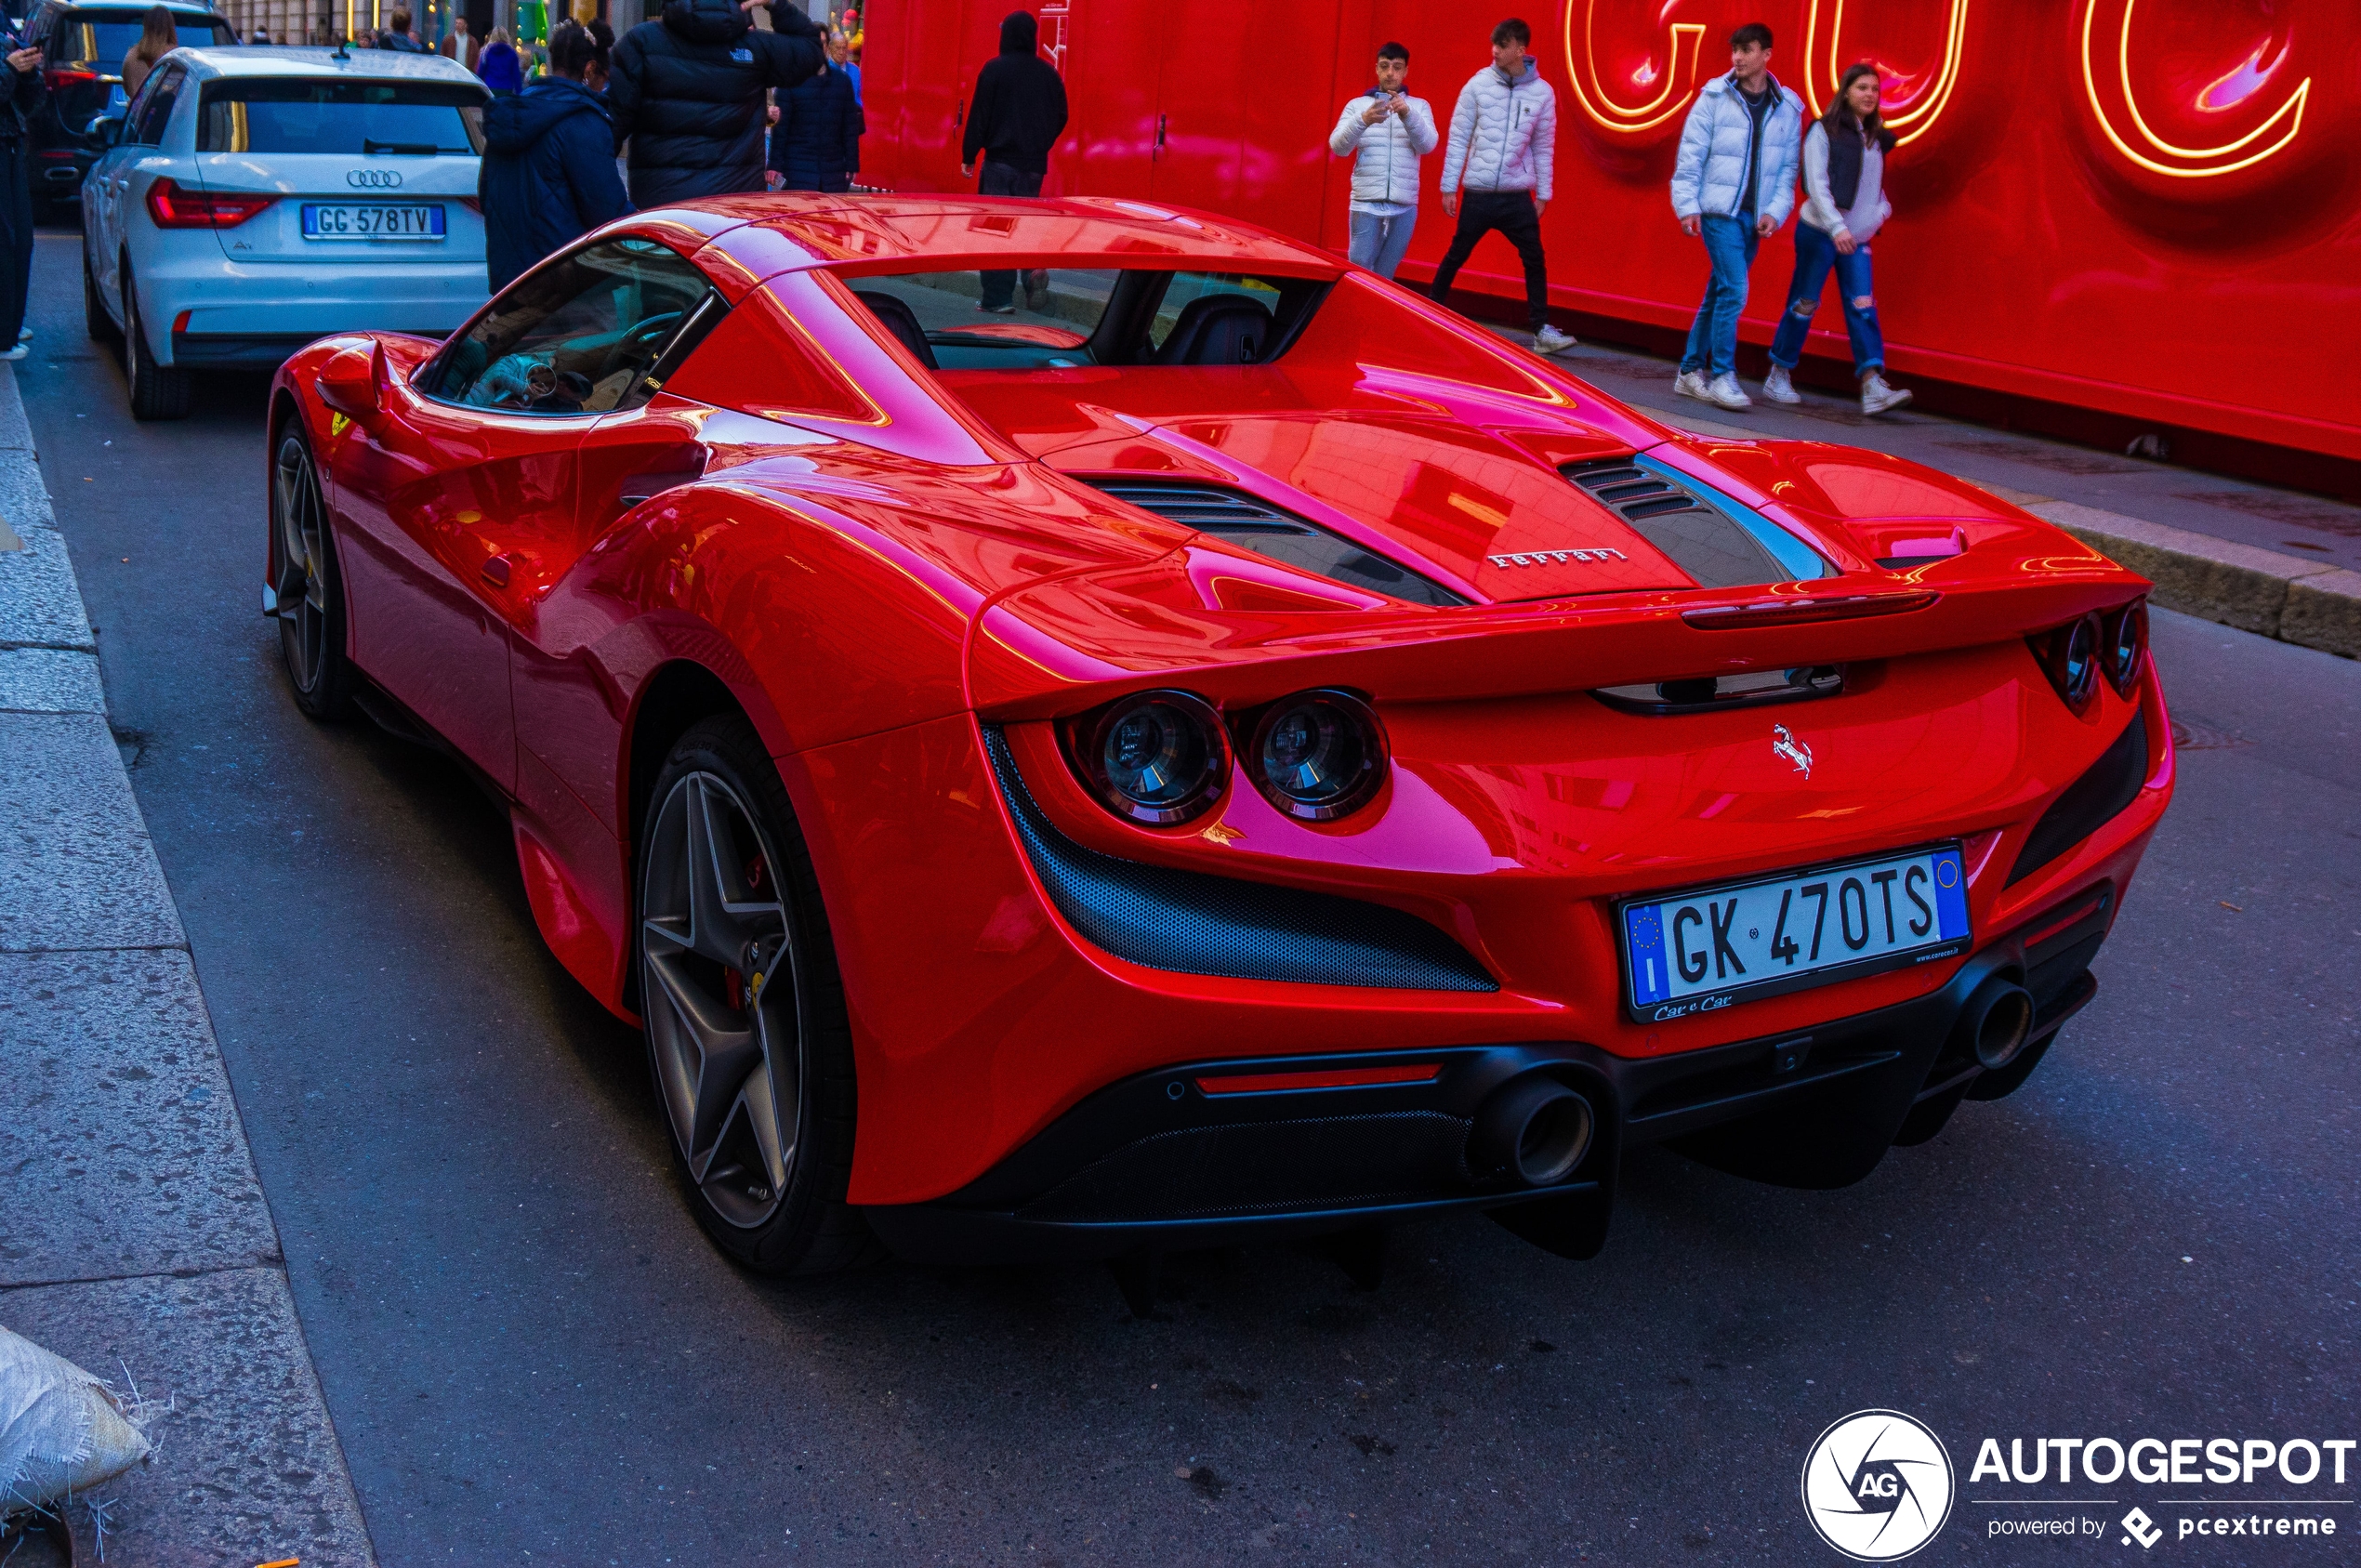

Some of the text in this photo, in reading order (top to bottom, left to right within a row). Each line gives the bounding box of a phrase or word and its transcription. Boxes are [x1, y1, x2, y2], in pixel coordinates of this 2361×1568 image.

[319, 209, 348, 231] GG
[357, 208, 428, 232] 578TV
[1487, 547, 1628, 568] Ferrari
[1673, 898, 1747, 983] GK
[1770, 864, 1933, 966] 470TS
[1655, 1005, 1687, 1021] Car
[1700, 995, 1733, 1011] Car
